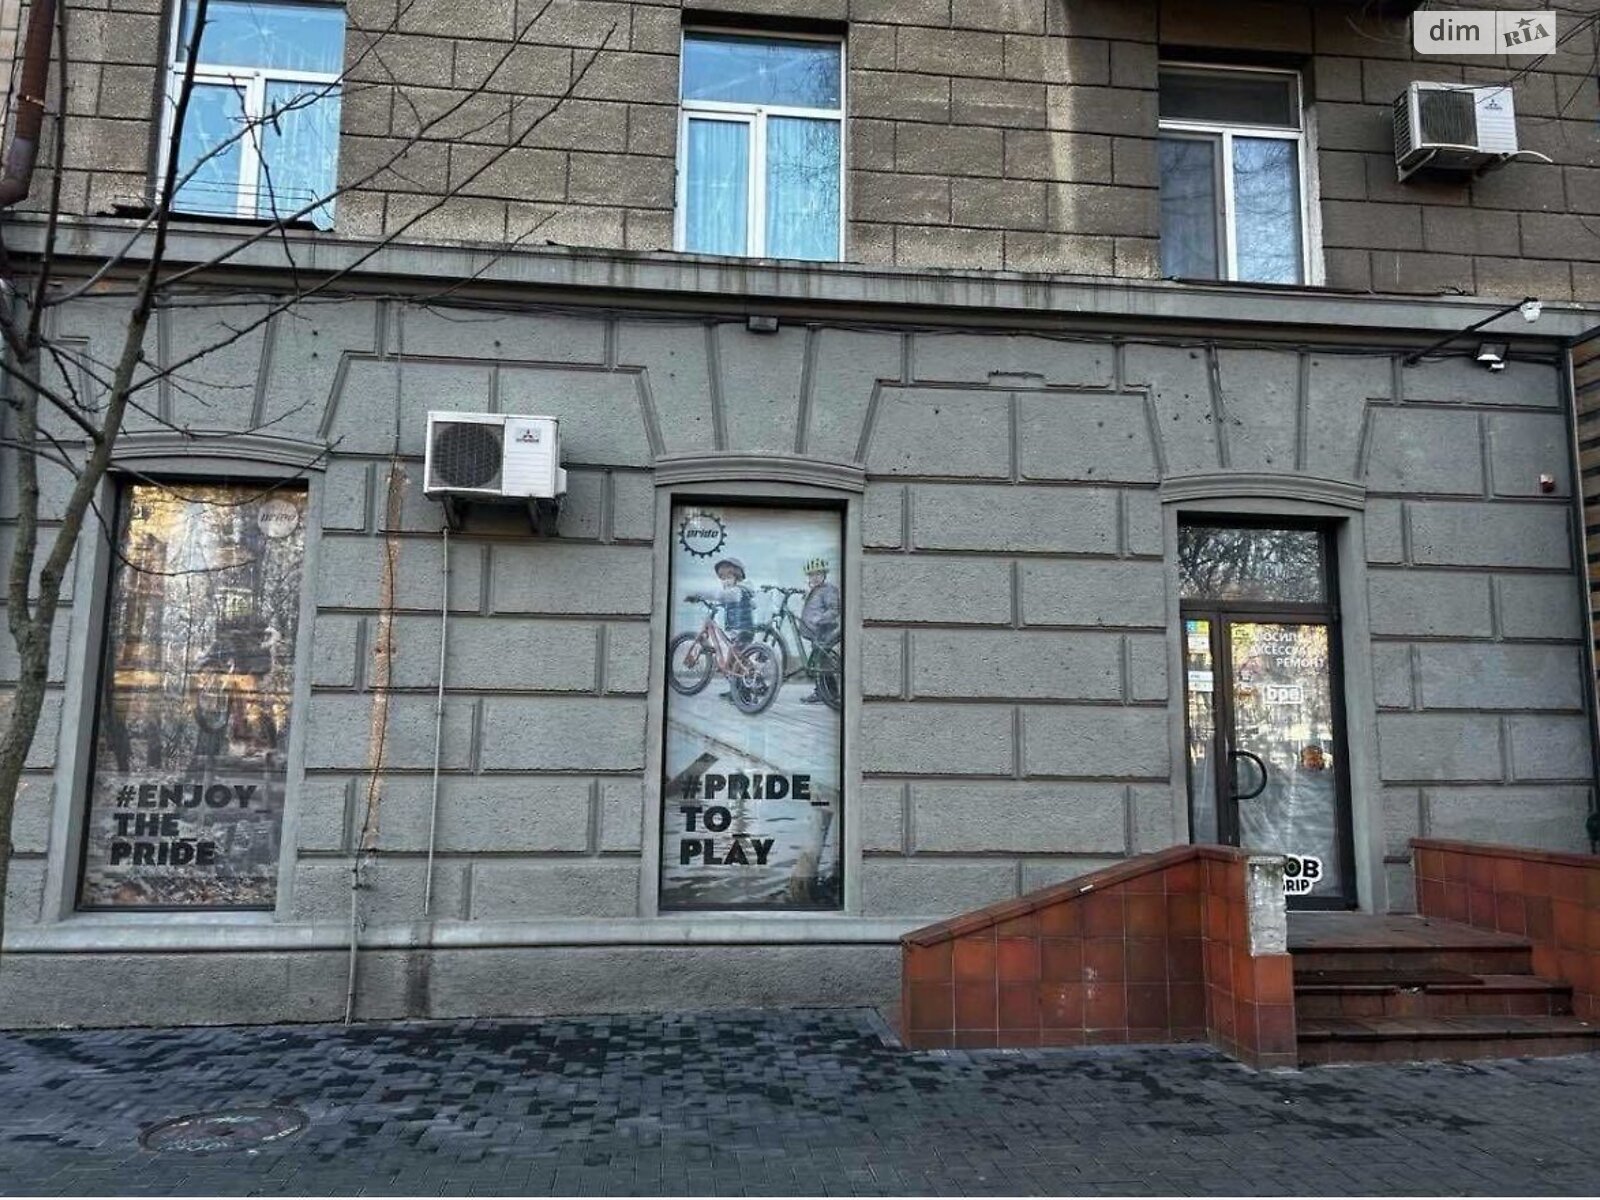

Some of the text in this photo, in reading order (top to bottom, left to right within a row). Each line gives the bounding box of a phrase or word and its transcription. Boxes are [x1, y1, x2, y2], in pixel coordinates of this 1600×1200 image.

[110, 842, 216, 865] PRIDE
[680, 838, 775, 865] PLAY
[1284, 857, 1320, 878] OB
[1282, 879, 1310, 892] RIP
